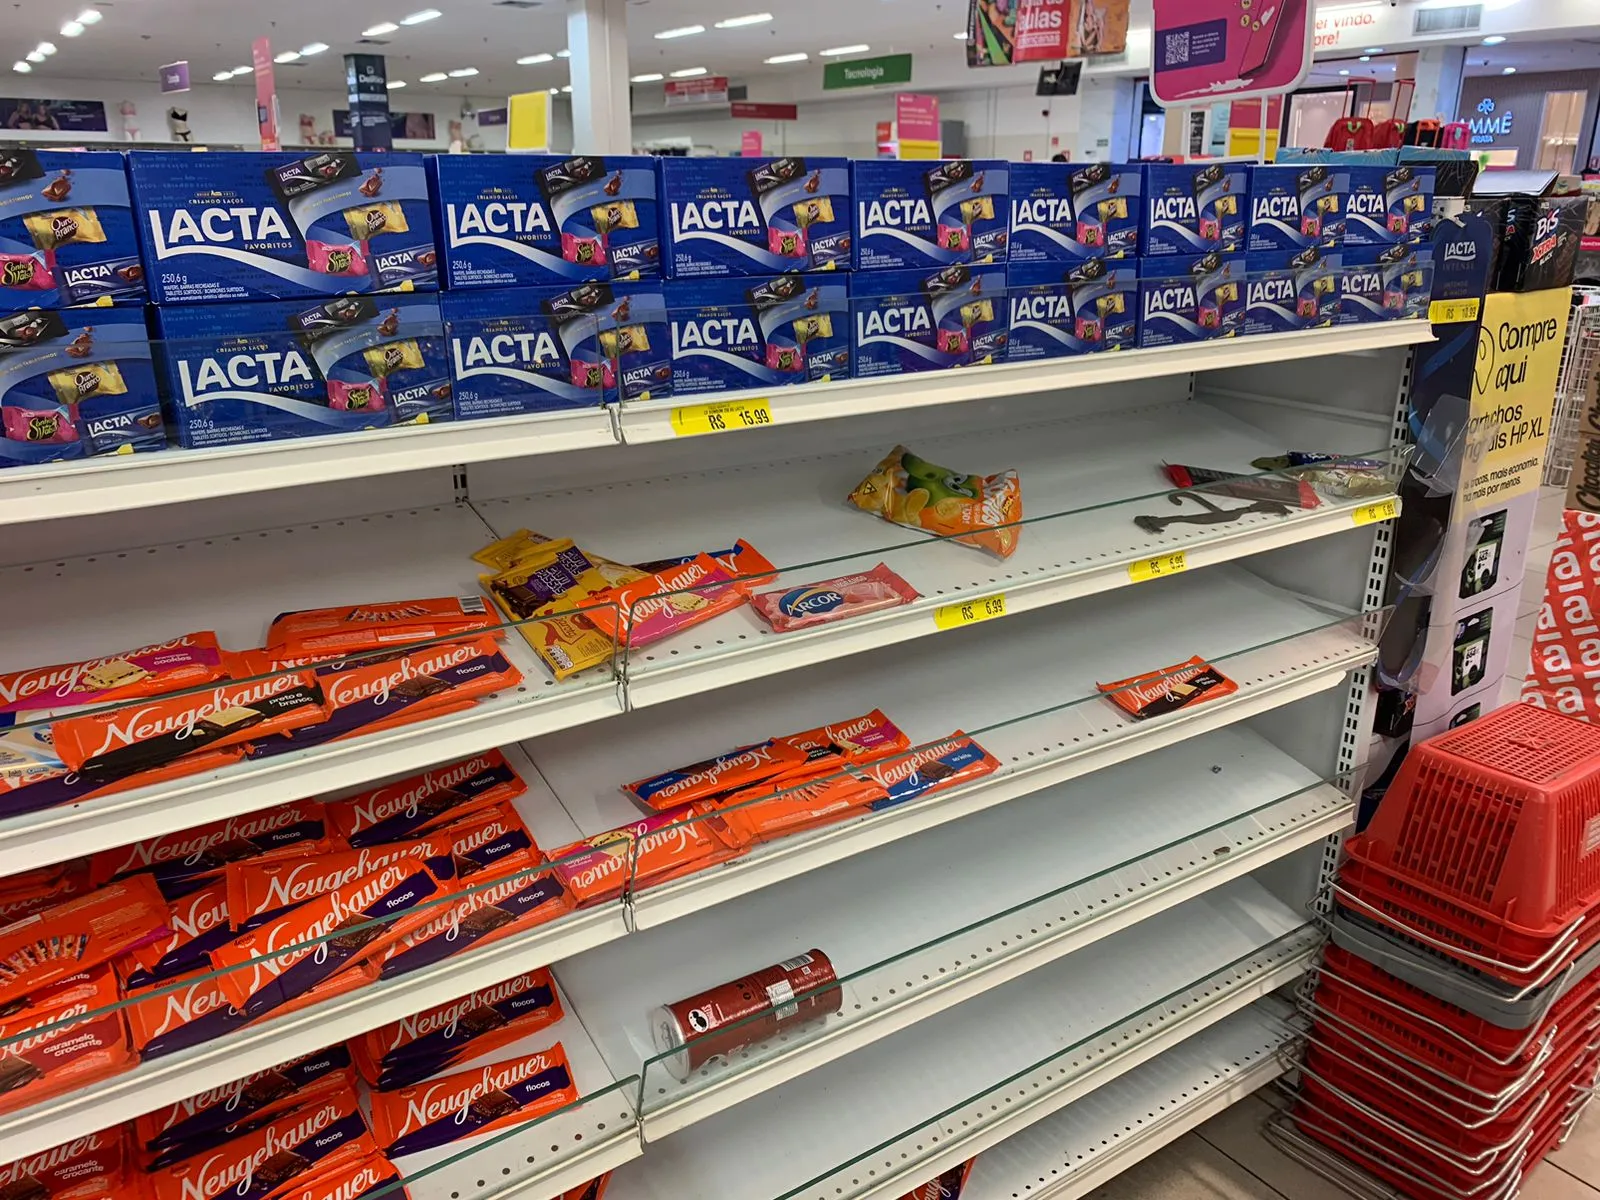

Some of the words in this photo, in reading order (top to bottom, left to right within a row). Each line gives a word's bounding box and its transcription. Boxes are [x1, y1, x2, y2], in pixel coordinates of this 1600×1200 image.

[844, 66, 884, 80] Tecnologia
[1151, 196, 1196, 230] LACTA
[1252, 195, 1299, 228] LACTA
[1346, 194, 1385, 214] ACTA
[52, 215, 73, 232] Ouro
[447, 202, 550, 249] LACTA
[671, 200, 760, 243] LACTA
[860, 199, 931, 239] LACTA
[1012, 199, 1072, 233] LACTA
[149, 206, 291, 260] LACTA
[244, 242, 293, 250] FAVORITOS
[612, 246, 640, 264] LACTA
[811, 239, 835, 253] LACTA
[1444, 241, 1476, 261] LACTA
[375, 252, 412, 274] LACTA
[64, 263, 112, 288] LACTA
[162, 273, 180, 284] 250,6
[1341, 273, 1381, 294] ACTA
[1144, 287, 1195, 323] LACTA
[1246, 279, 1294, 312] LACTA
[1010, 295, 1071, 331] LACTA
[857, 304, 931, 347] LACTA
[1499, 317, 1558, 353] Compre
[671, 318, 758, 361] LACTA
[452, 331, 560, 382] LACTA
[808, 351, 833, 367] LACTA
[74, 371, 96, 386] Ouro
[177, 350, 313, 408] LACTA
[622, 367, 651, 386] LACTA
[1495, 355, 1528, 392] aqui
[269, 382, 315, 393] FAVORITOS
[392, 386, 428, 407] LACTA
[87, 413, 131, 438] LACTA
[189, 419, 207, 429] 250,6
[739, 408, 770, 425] 15.99
[1510, 422, 1529, 447] HP
[1528, 416, 1545, 440] XL
[1490, 468, 1508, 481] mais
[1508, 457, 1539, 476] economia.
[1487, 484, 1500, 497] por
[1500, 476, 1521, 491] menos.
[617, 562, 708, 632] Neugebauer
[786, 591, 842, 617] ARCOR
[153, 654, 193, 666] cookies
[455, 663, 486, 675] flocos
[268, 694, 294, 706] preto
[294, 692, 303, 700] e
[1127, 665, 1203, 710] Neugebauer
[278, 696, 314, 709] branco
[92, 674, 304, 758] Neugebauer
[825, 716, 877, 743] bauer
[655, 745, 775, 799] Neugebauer
[870, 737, 962, 787] Neugebauer
[470, 774, 495, 787] flocos
[351, 757, 490, 834] Neugebauer
[115, 807, 306, 875] Neugebauer
[272, 830, 301, 841] flocos
[485, 841, 511, 855] flocos
[570, 808, 700, 890] Neugebauer
[385, 890, 415, 909] flocos
[517, 889, 545, 904] flocos
[249, 863, 408, 994] Neugebauer
[389, 972, 537, 1051] Neugebauer
[511, 997, 535, 1009] flocos
[43, 1032, 95, 1055] caramelo
[54, 1038, 103, 1058] crocante
[303, 1059, 331, 1073] flocos
[397, 1053, 552, 1139] Neugebauer
[525, 1079, 551, 1092] flocos
[314, 1130, 344, 1148] flocos
[181, 1102, 343, 1200] Neugebauer
[54, 1159, 98, 1176] caramelo
[62, 1164, 104, 1180] crocante
